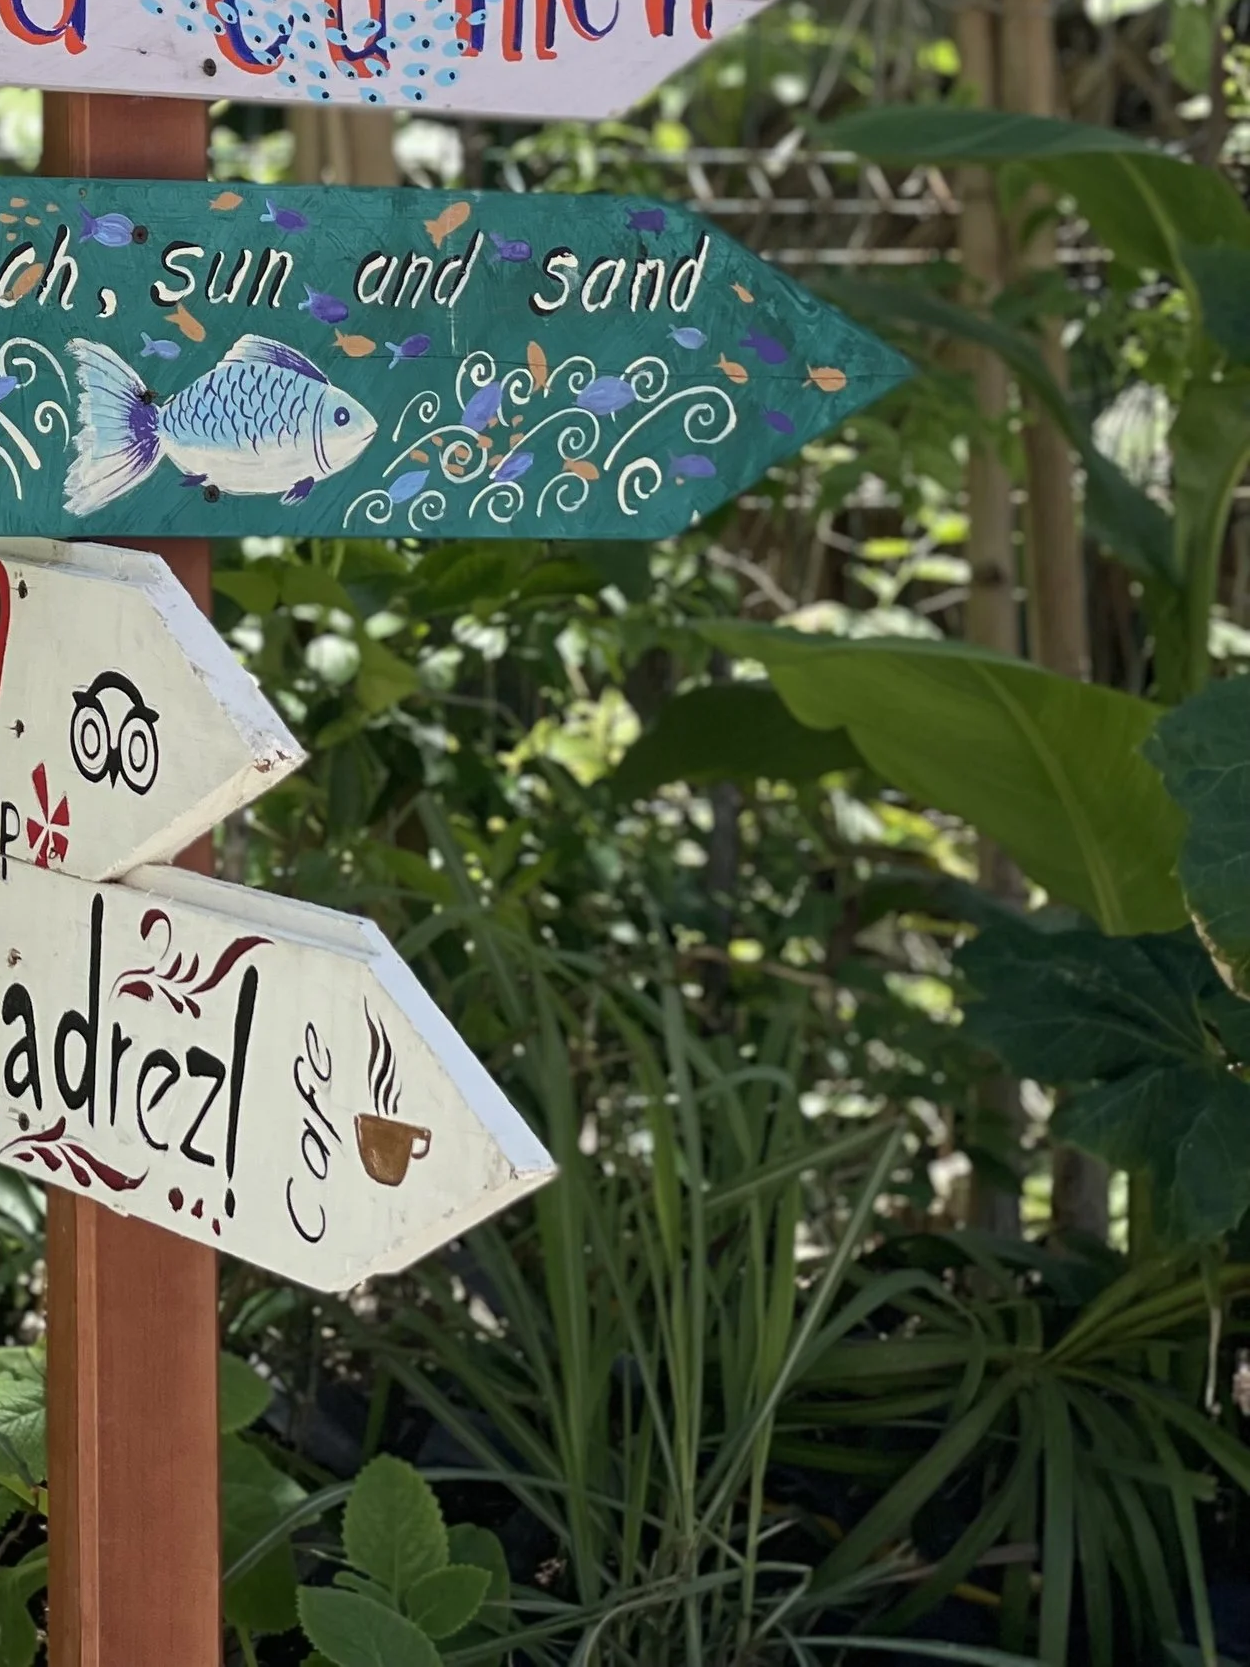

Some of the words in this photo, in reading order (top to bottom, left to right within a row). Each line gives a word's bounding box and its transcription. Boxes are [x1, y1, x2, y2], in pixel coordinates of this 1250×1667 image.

[151, 240, 294, 308] sun
[353, 228, 485, 310] and
[528, 229, 711, 317] sand
